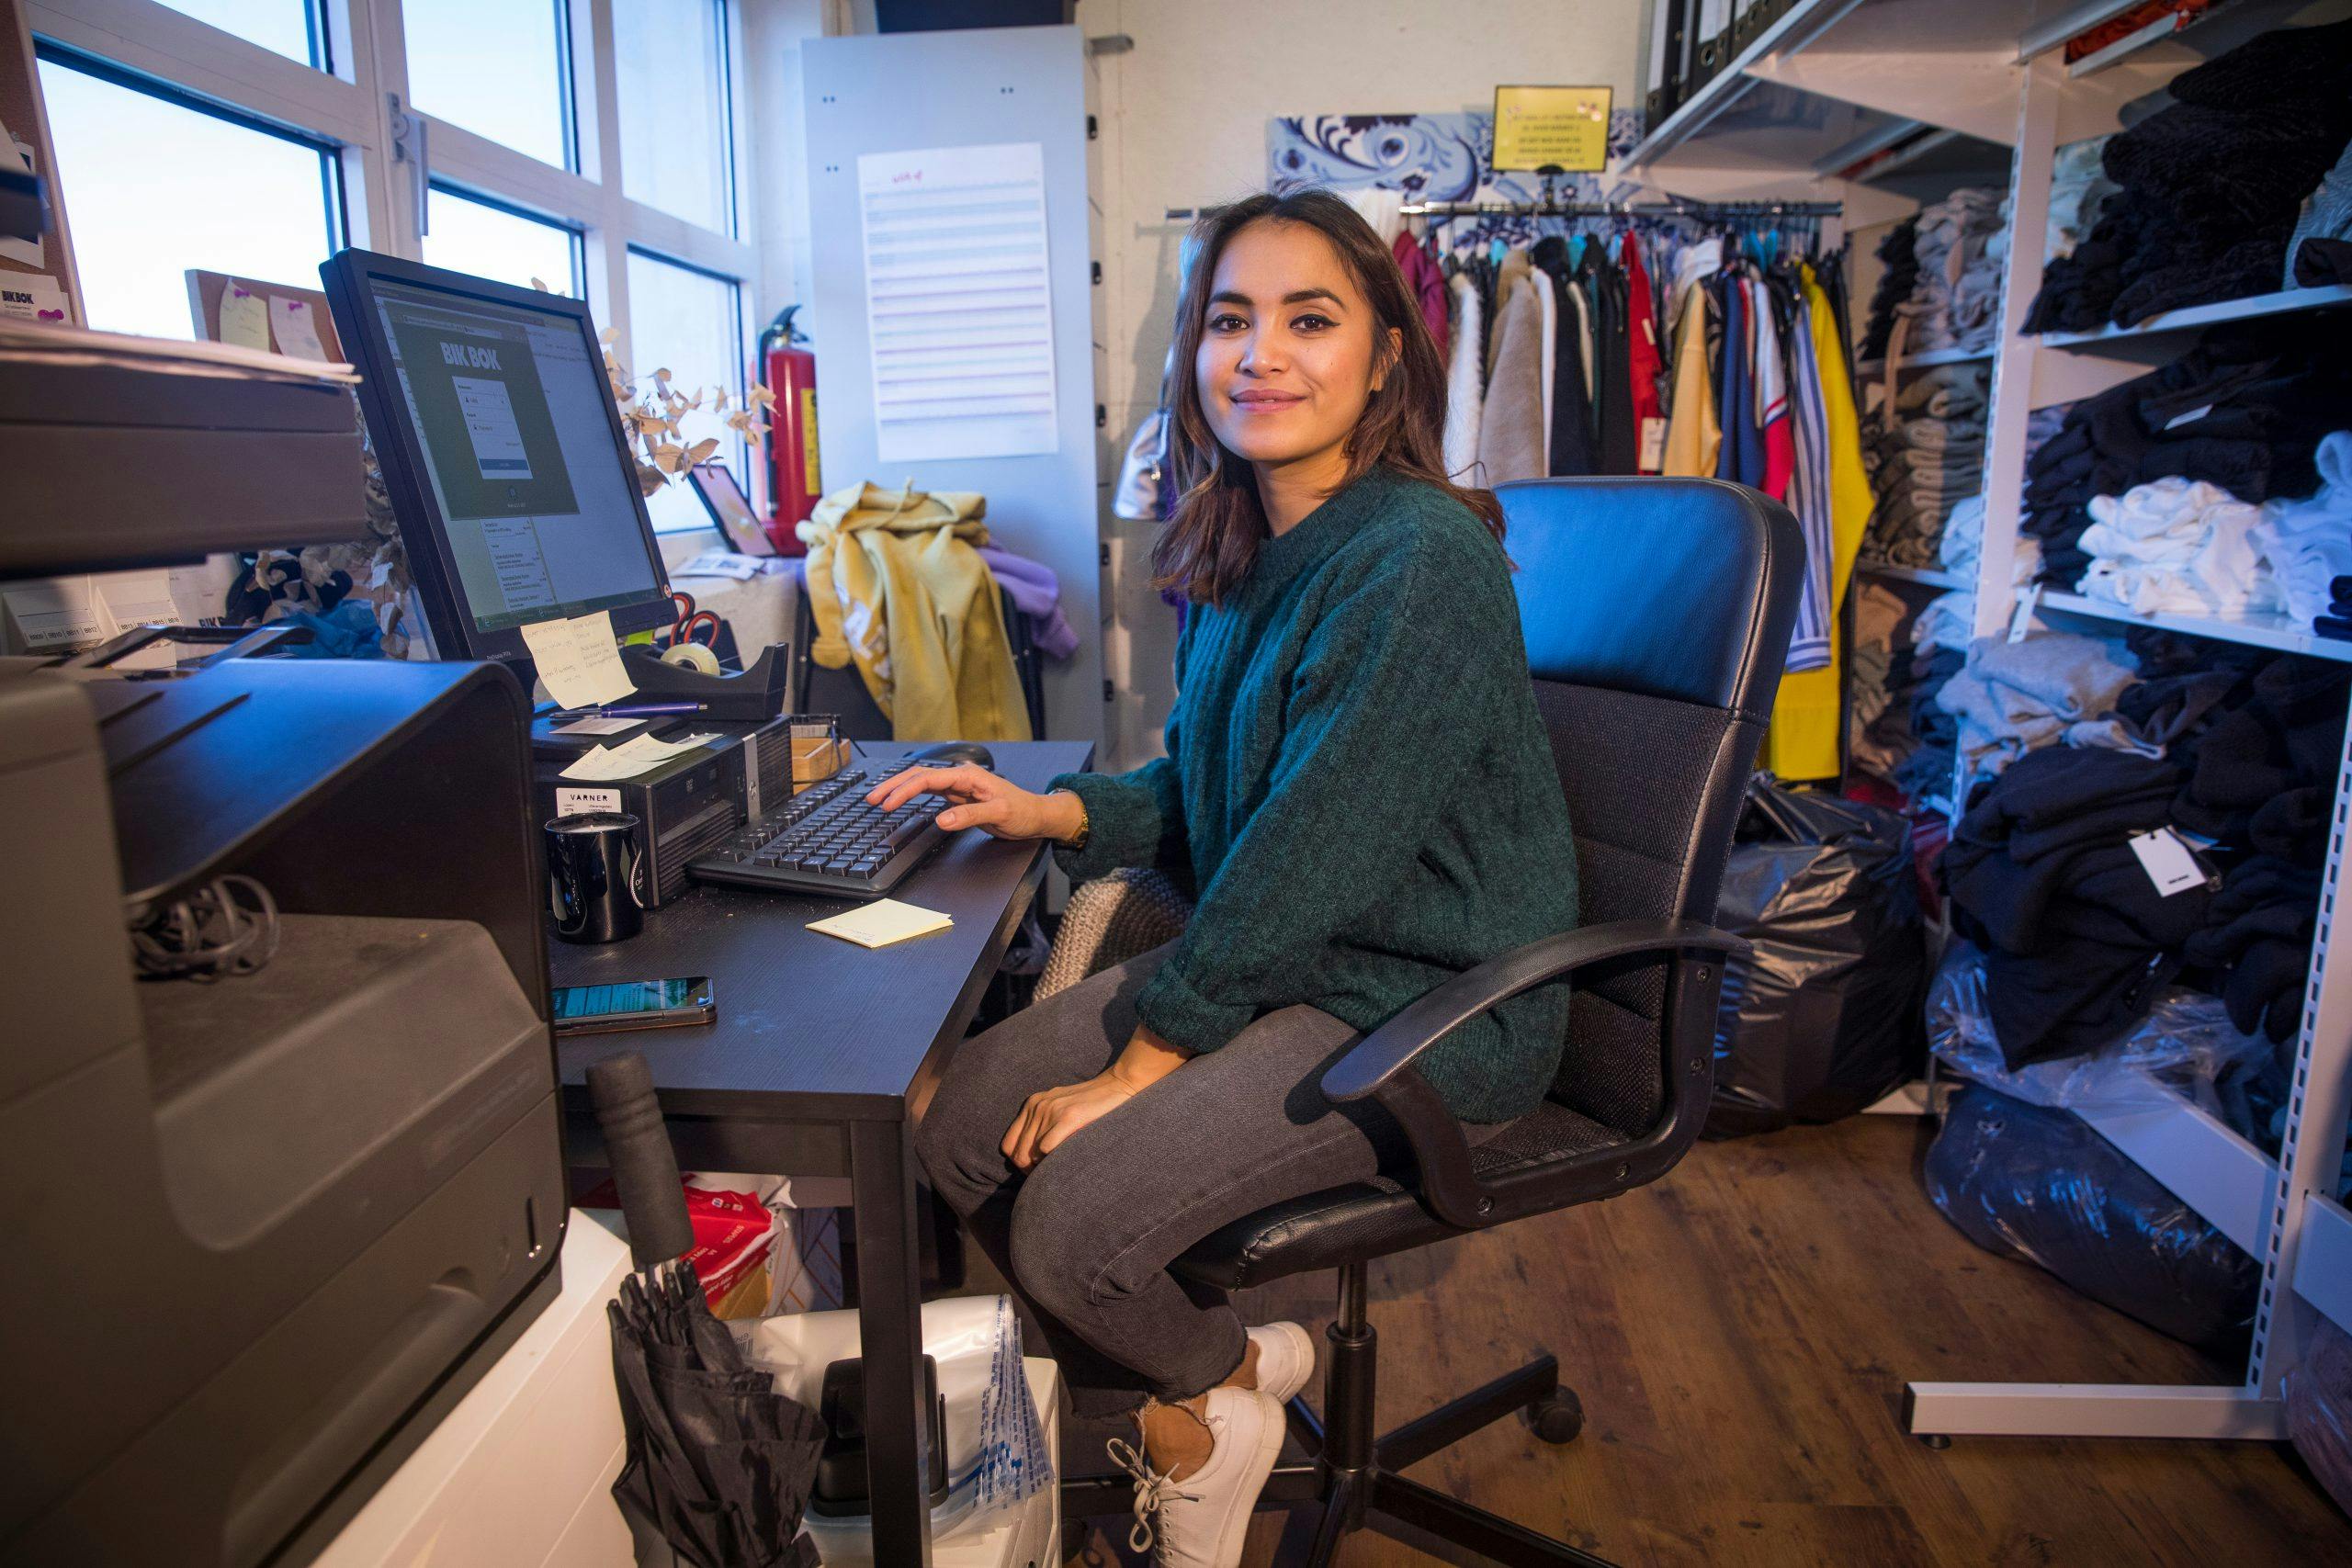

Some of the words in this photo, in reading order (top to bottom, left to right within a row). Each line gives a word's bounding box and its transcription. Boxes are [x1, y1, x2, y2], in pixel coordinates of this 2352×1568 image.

[2, 290, 16, 302] BIK
[15, 292, 35, 304] BOK
[440, 342, 470, 367] BIK
[467, 345, 502, 370] BOK
[570, 794, 608, 802] VARNER
